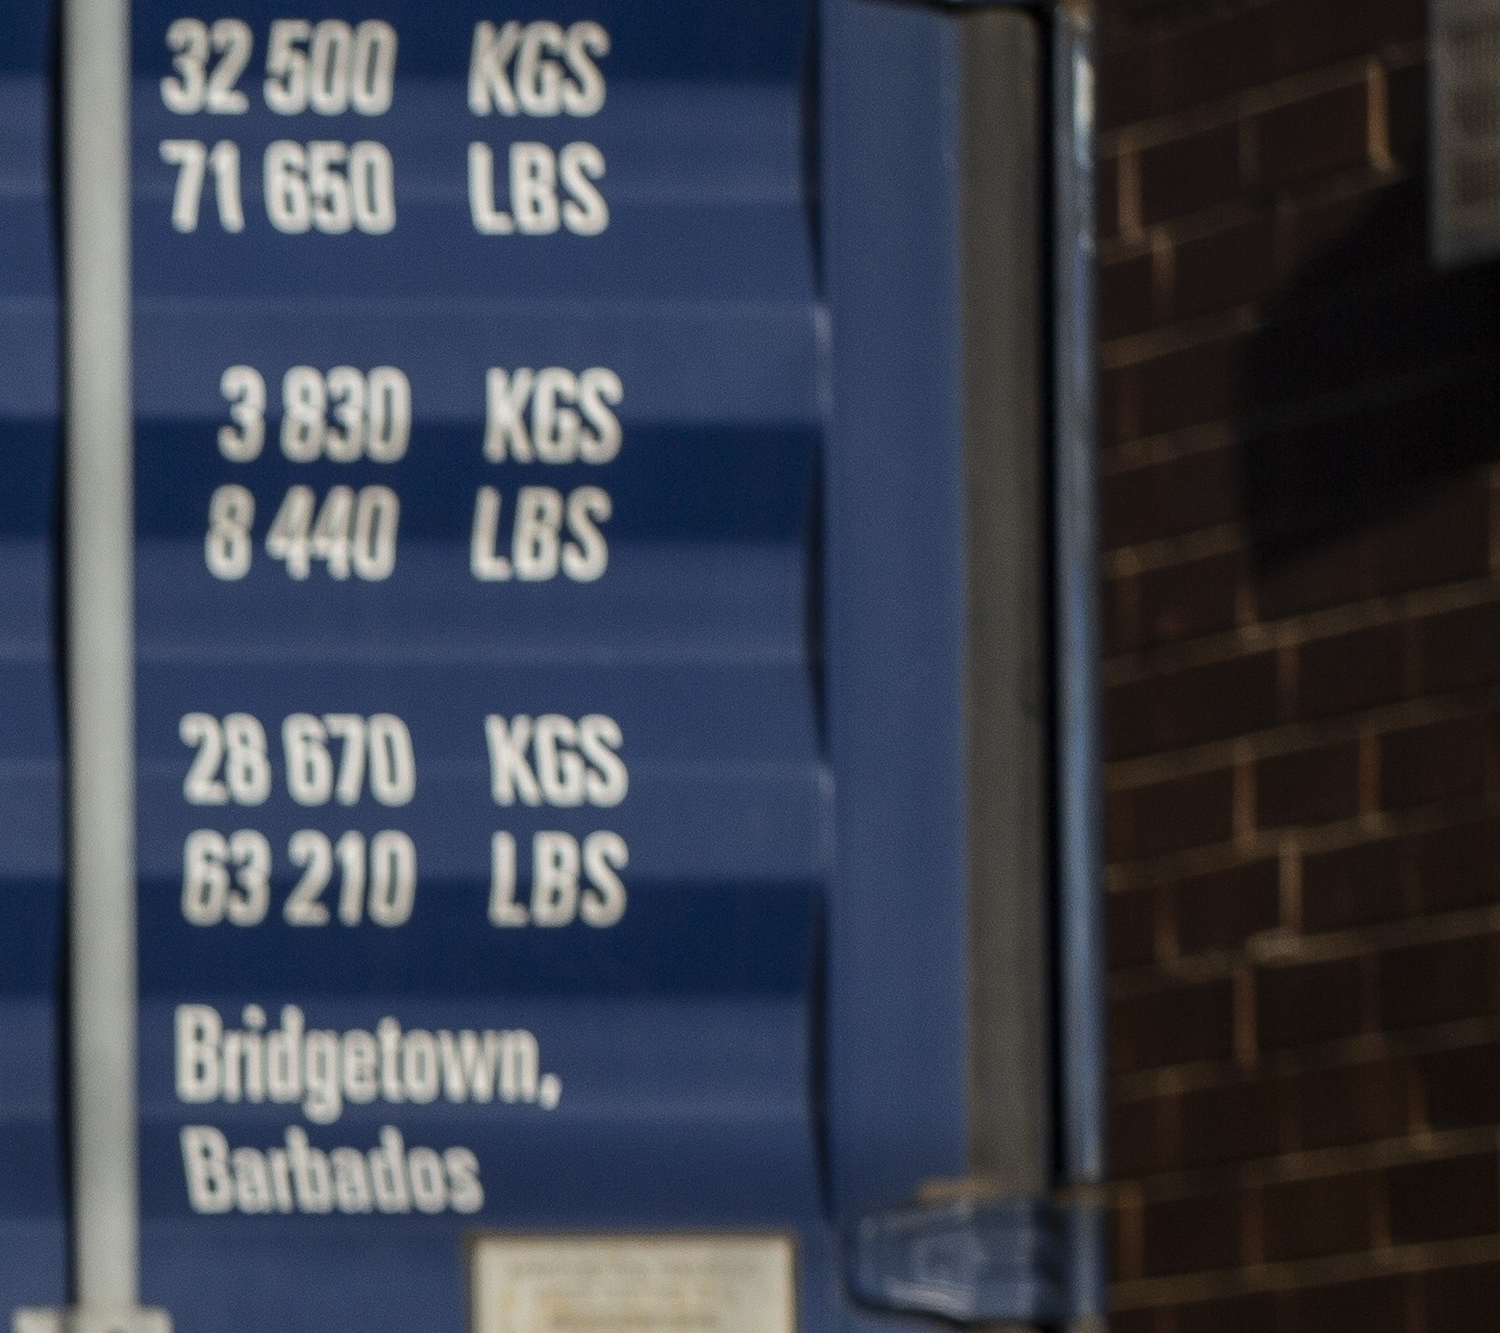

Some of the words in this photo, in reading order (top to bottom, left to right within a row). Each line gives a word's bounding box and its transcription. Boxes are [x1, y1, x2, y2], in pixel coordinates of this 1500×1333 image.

[160, 19, 251, 114] 32
[263, 21, 397, 115] 500
[468, 22, 609, 116] KGS
[159, 139, 245, 232] 71
[263, 140, 397, 234] 650
[468, 142, 609, 235] LBS
[219, 365, 267, 460] 3
[281, 366, 412, 461] 830
[485, 367, 624, 462] KGS
[205, 486, 255, 580] 8
[265, 486, 399, 581] 440
[470, 487, 611, 581] LBS
[179, 713, 271, 804] 28
[282, 713, 417, 806] 670
[485, 714, 630, 806] KGS
[183, 830, 271, 923] 63
[285, 830, 417, 925] 210
[490, 831, 630, 925] LBS
[175, 1005, 563, 1123] Bridgetown,
[181, 1126, 484, 1212] Barbados
